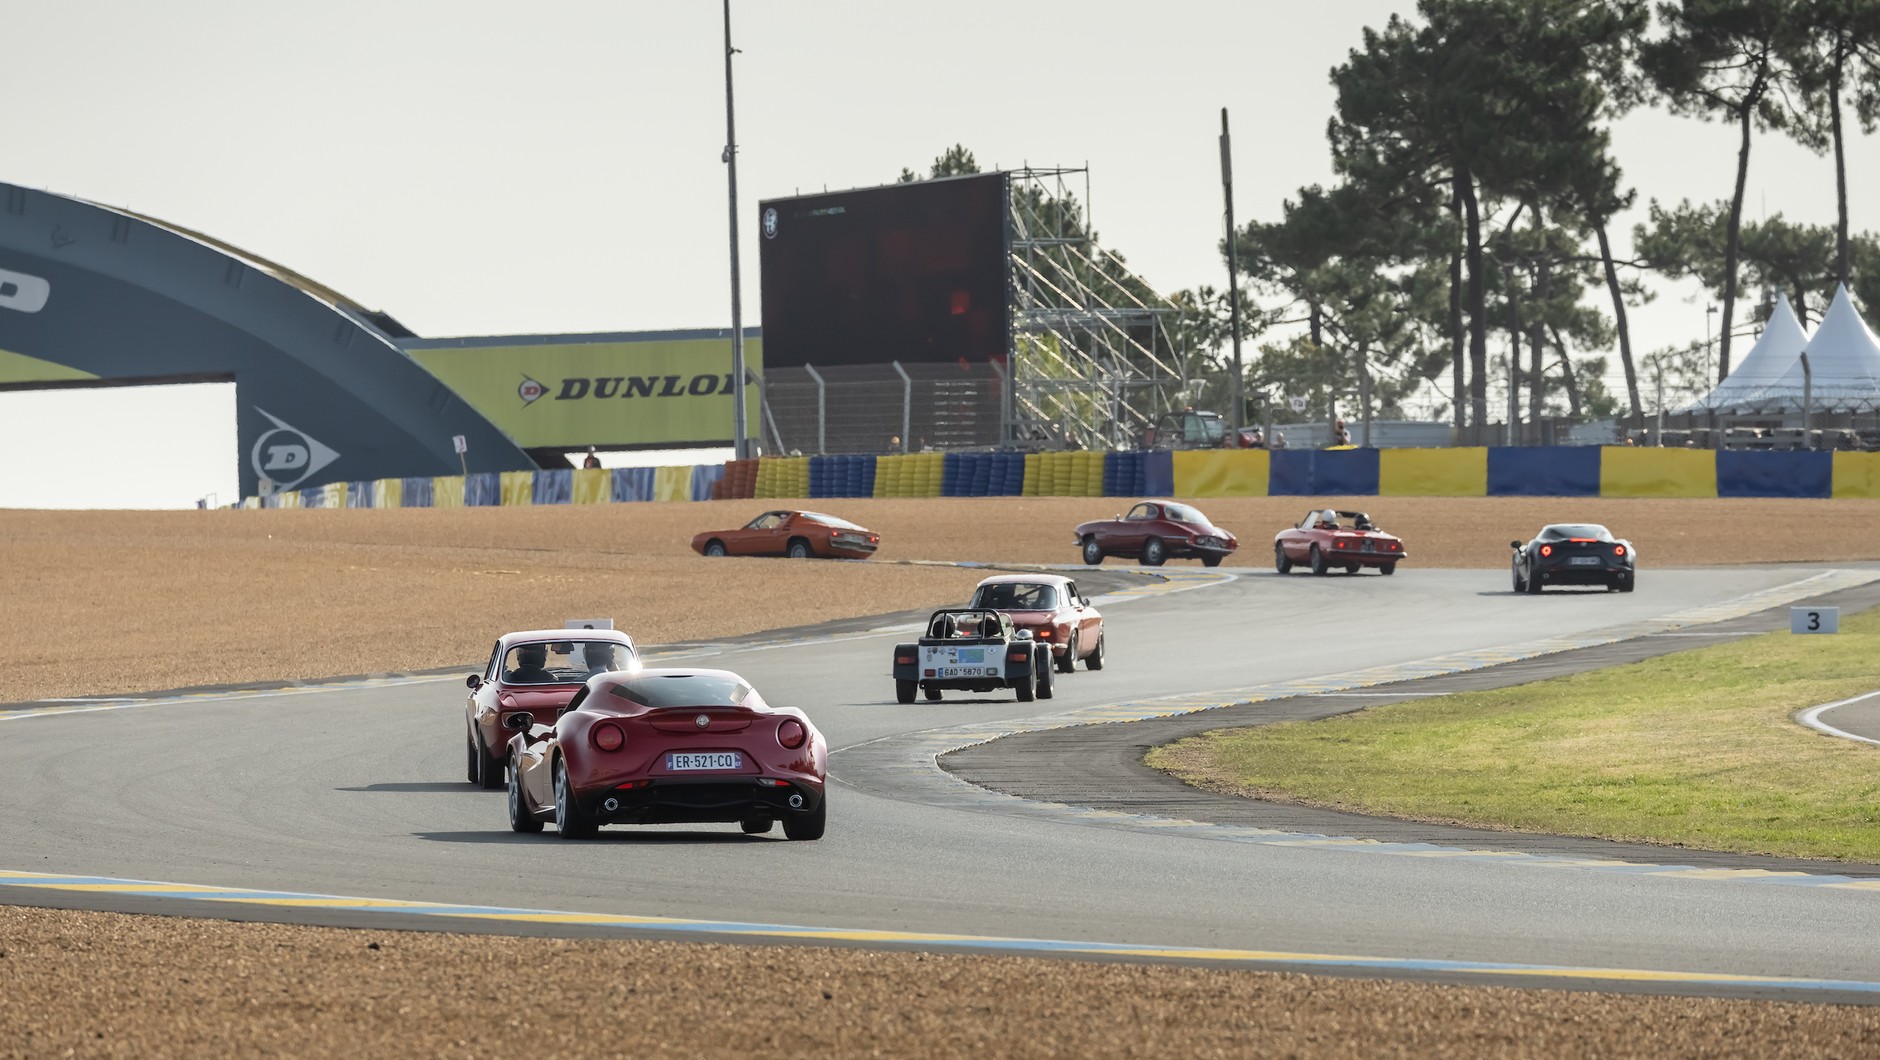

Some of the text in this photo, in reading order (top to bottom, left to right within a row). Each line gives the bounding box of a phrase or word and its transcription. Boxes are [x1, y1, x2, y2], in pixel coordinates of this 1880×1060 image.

[264, 444, 308, 470] D
[1807, 611, 1820, 631] 3
[963, 668, 982, 676] 5870
[676, 754, 733, 768] ER-521-CQ
